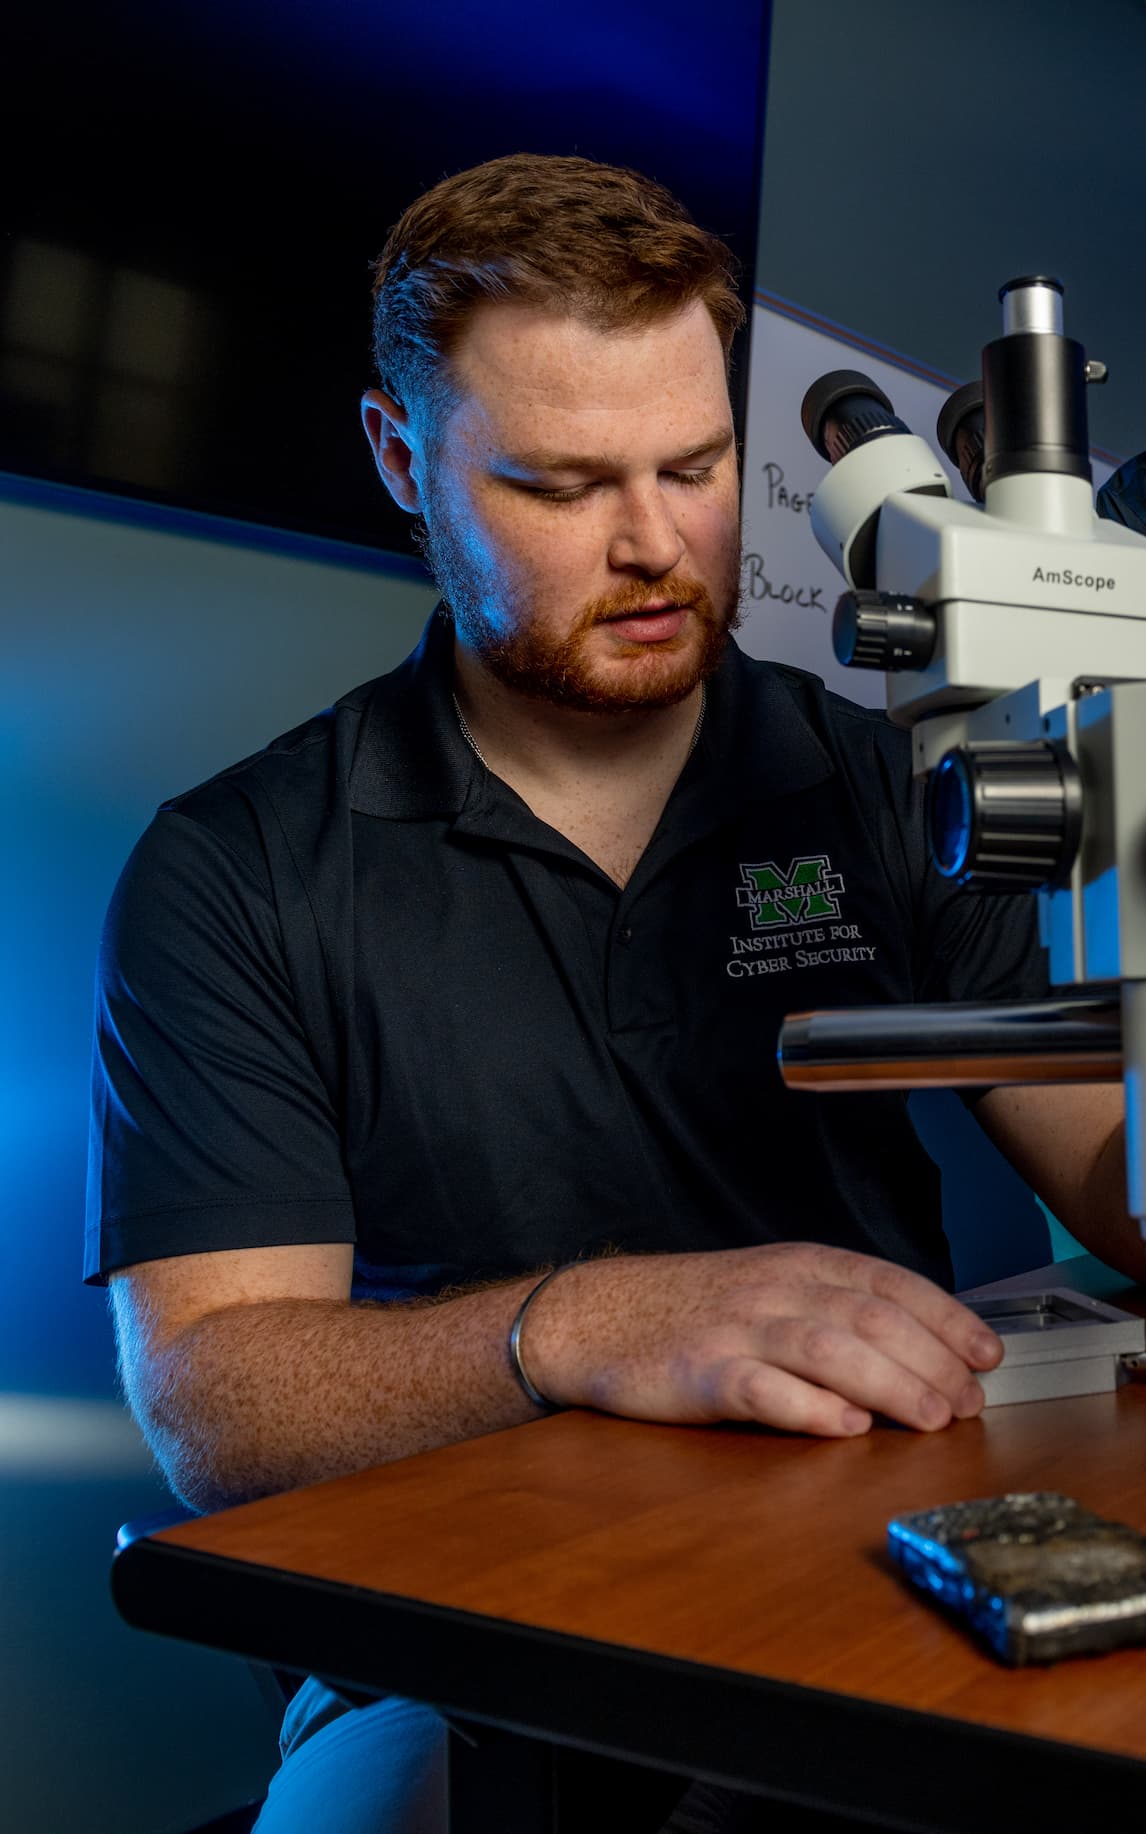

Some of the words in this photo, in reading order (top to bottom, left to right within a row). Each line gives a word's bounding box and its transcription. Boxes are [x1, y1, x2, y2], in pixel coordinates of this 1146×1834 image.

[1032, 566, 1115, 592] AmScope
[747, 879, 836, 904] MARSHALL
[730, 928, 826, 955] INSTITUTE
[829, 924, 863, 940] FOR
[726, 957, 793, 978] CYBER
[795, 946, 877, 968] SECURITY
